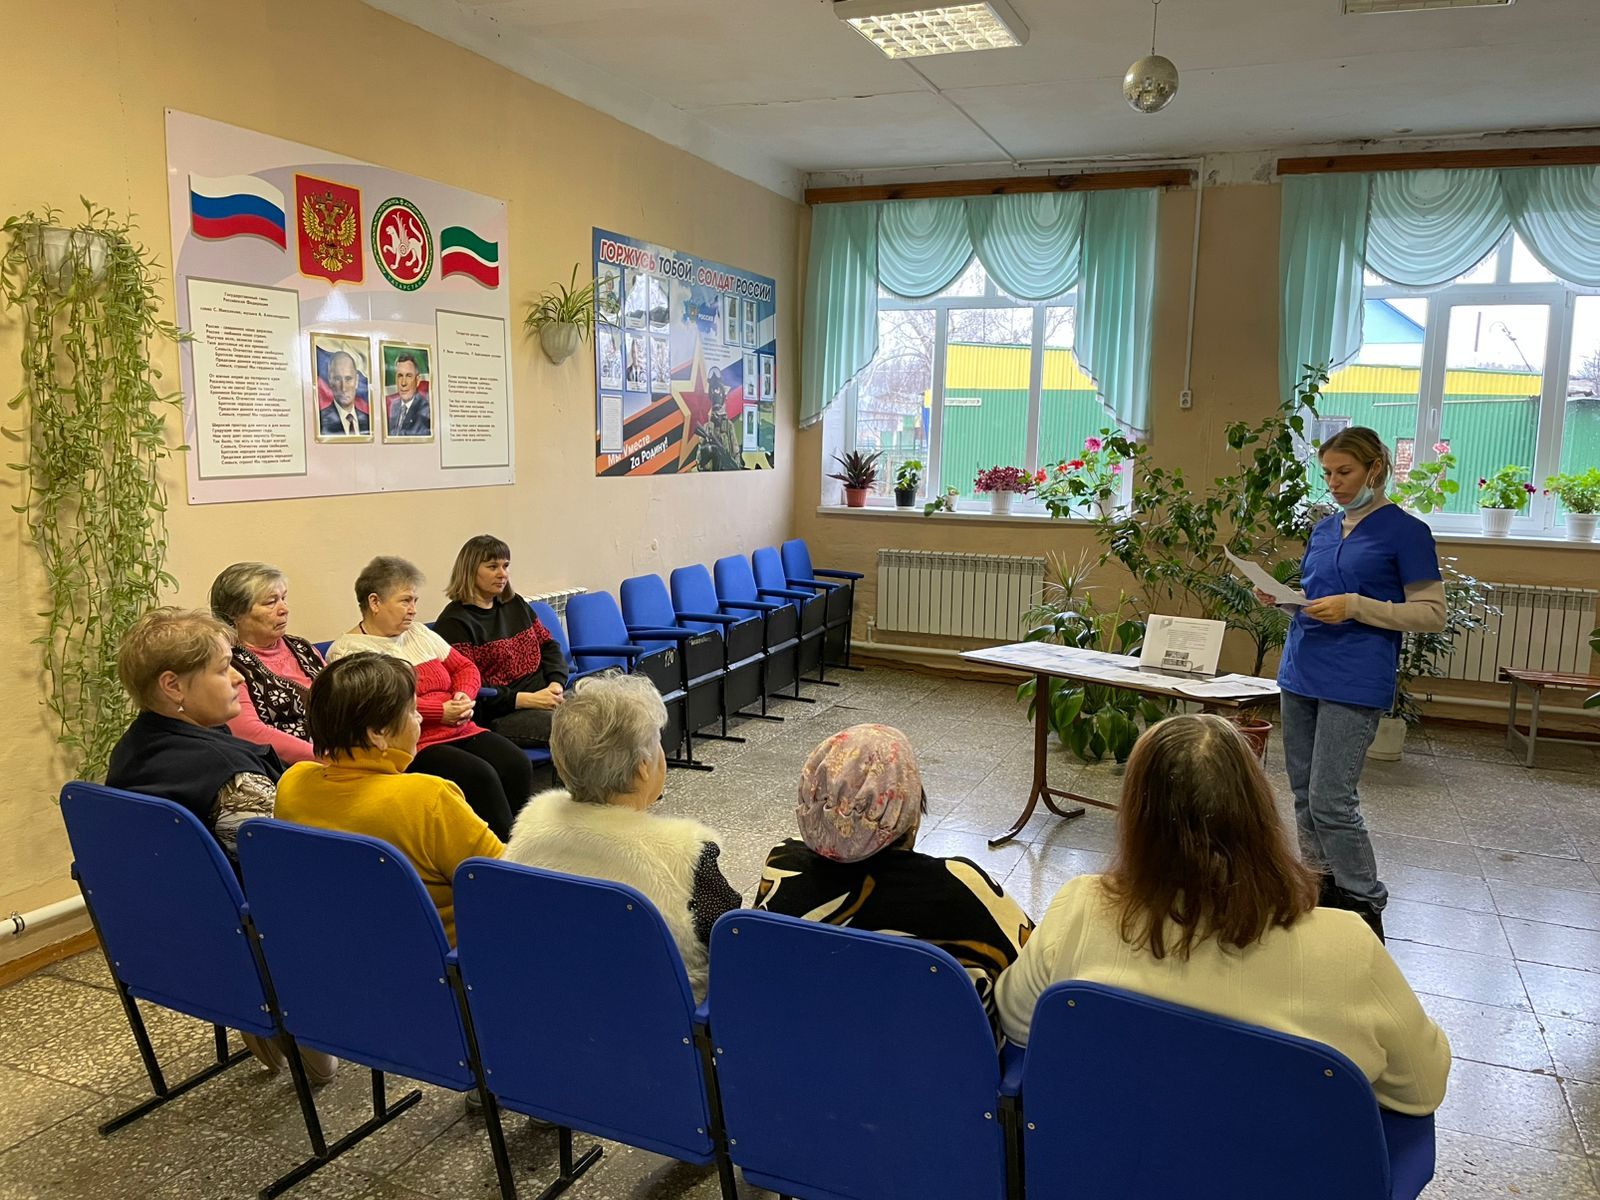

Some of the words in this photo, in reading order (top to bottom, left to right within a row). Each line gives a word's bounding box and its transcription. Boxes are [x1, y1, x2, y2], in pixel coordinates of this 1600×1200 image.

[600, 239, 656, 272] ГОРЖУСЬ
[658, 256, 696, 285] ТОБОЙ,
[697, 267, 735, 292] СОЛДАТ
[735, 278, 772, 301] РОССИИ
[641, 436, 669, 463] Родину!
